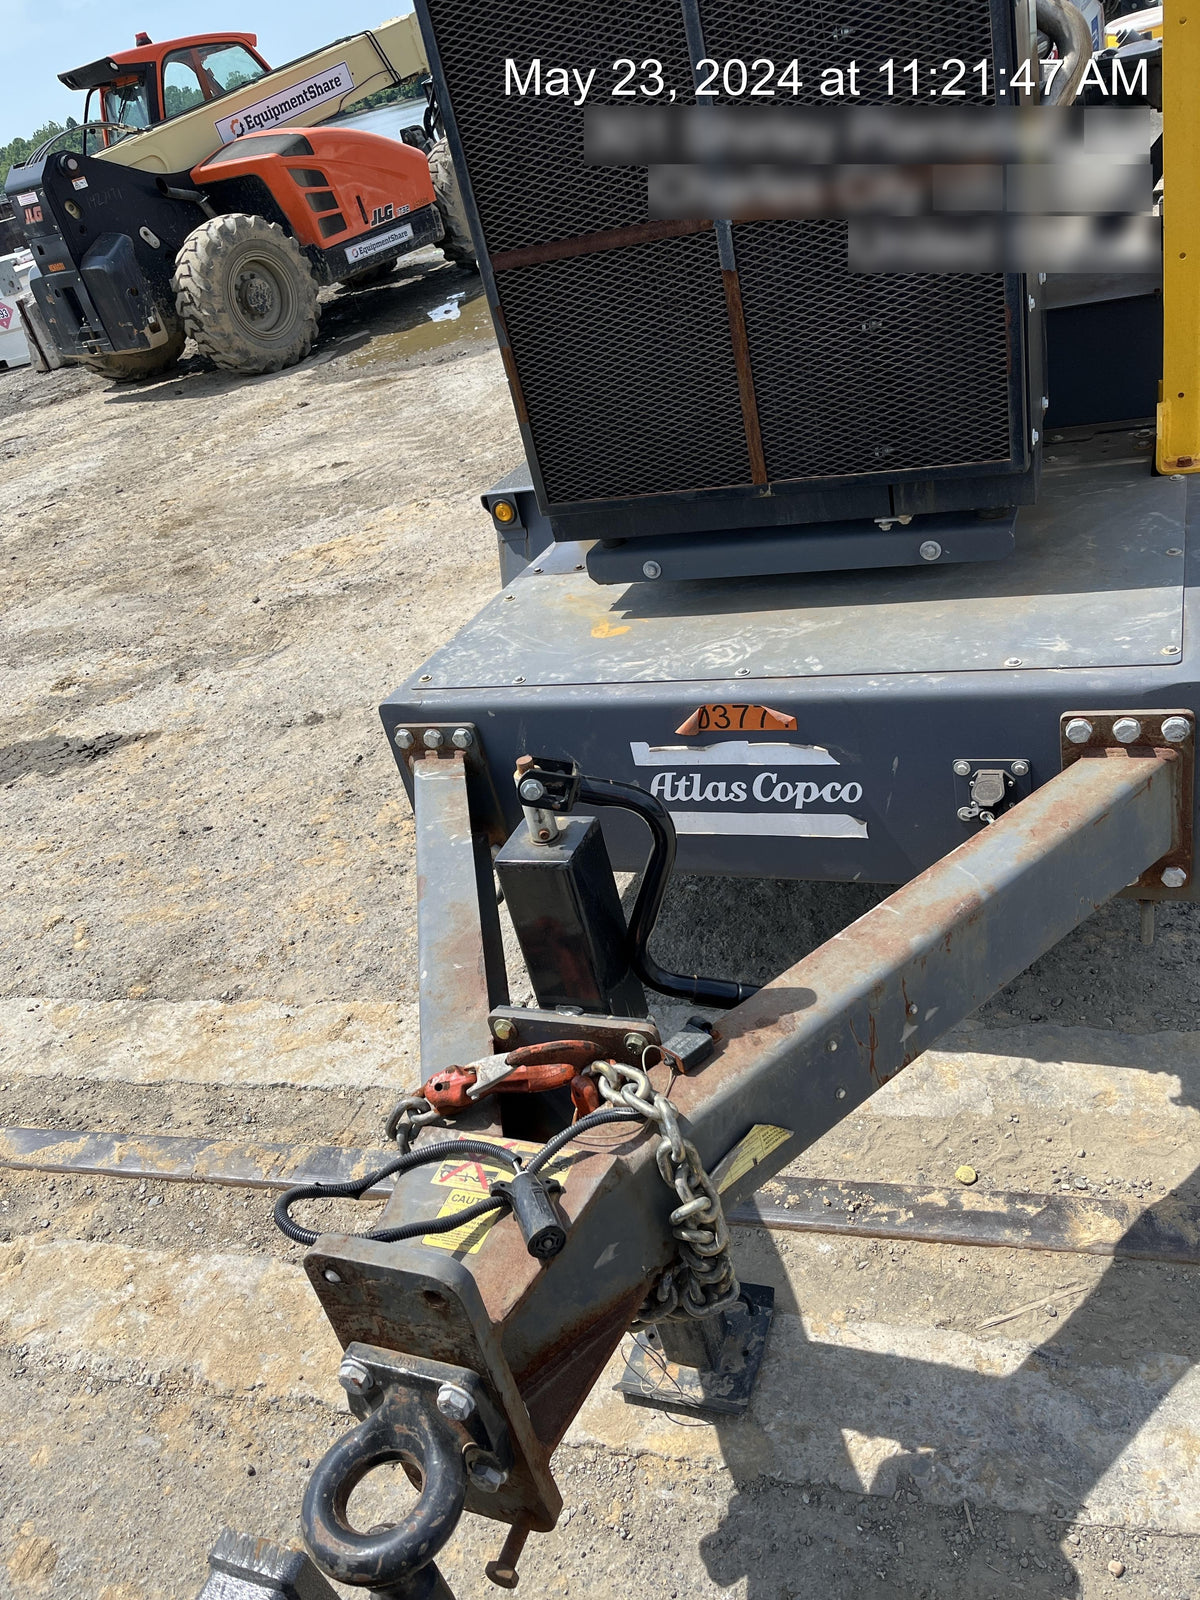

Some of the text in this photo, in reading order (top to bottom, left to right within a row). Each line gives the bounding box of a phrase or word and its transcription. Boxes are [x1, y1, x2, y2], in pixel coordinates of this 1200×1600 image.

[243, 75, 342, 129] EquipmentShare
[24, 205, 44, 225] JLG
[370, 203, 396, 228] JLG
[358, 229, 409, 254] EquipmentShare
[651, 772, 863, 810] Atlas Copco
